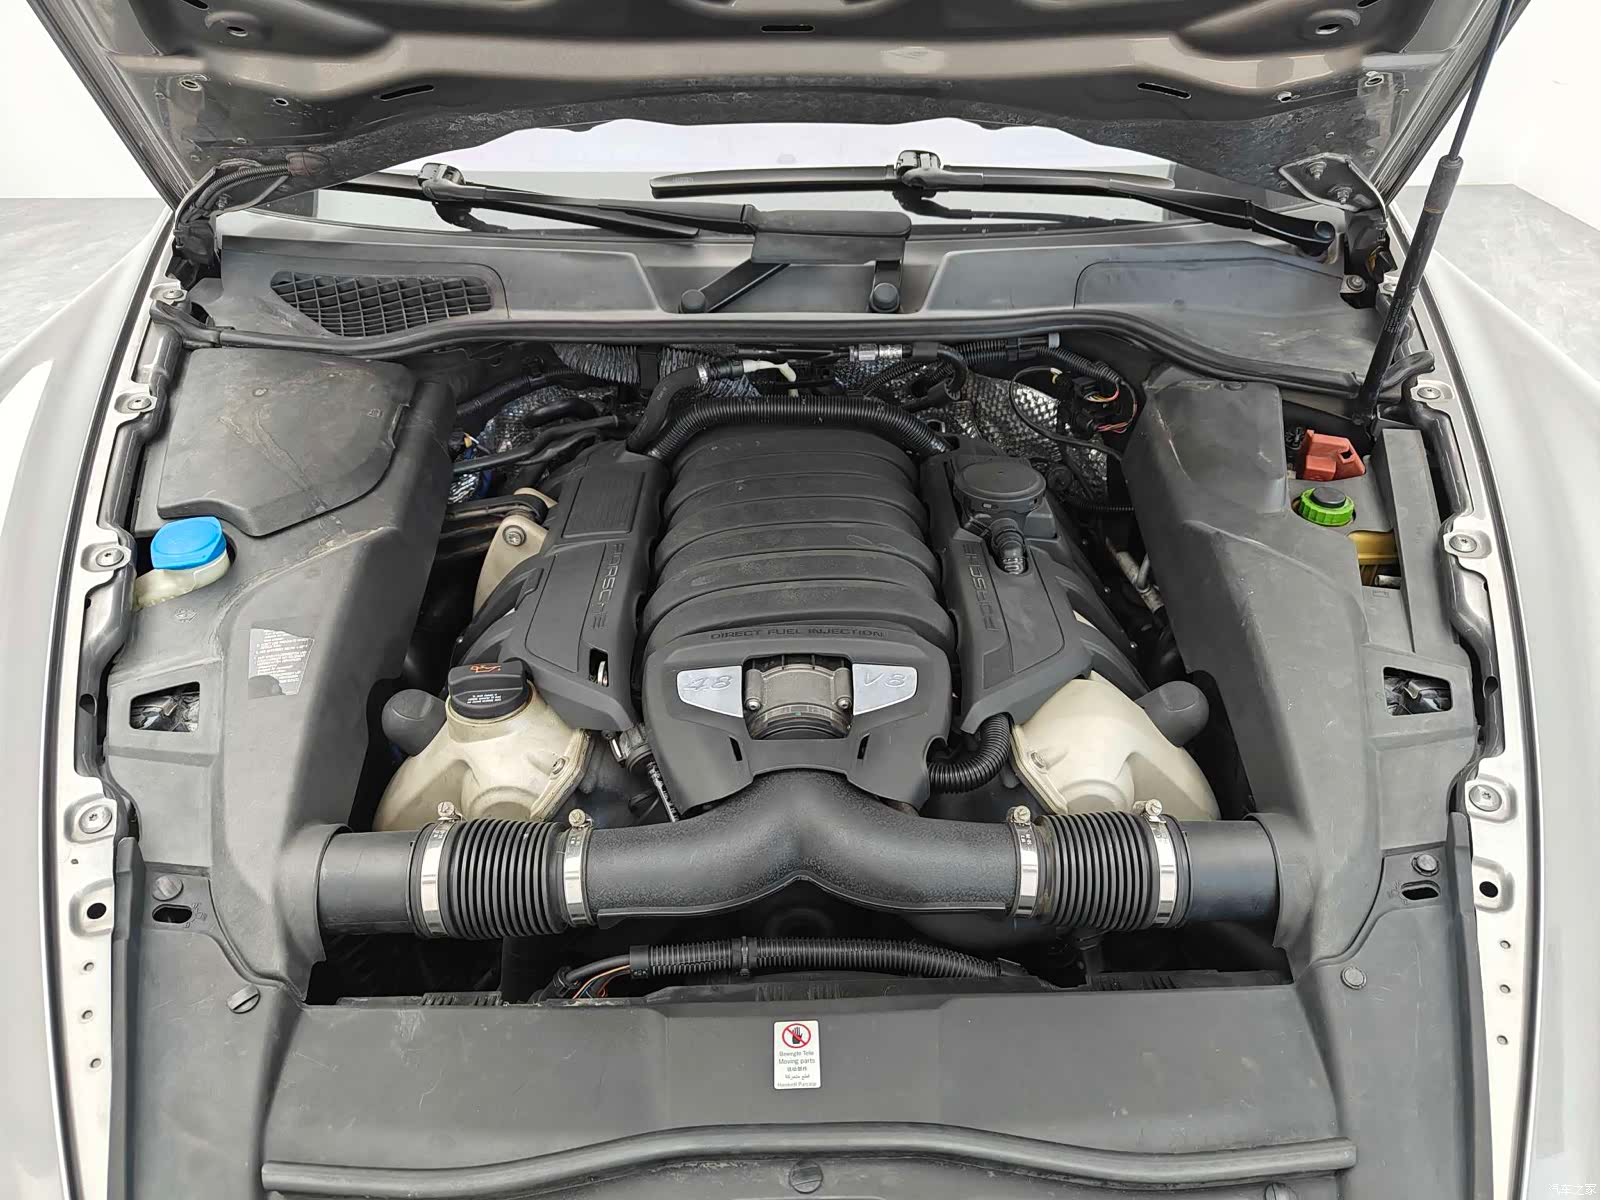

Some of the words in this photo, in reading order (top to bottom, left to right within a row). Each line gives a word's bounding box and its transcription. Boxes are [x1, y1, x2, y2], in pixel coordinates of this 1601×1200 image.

[592, 543, 624, 629] PORSCHE
[963, 543, 1000, 632] PORSCHE
[710, 629, 761, 640] DIRECT
[767, 628, 801, 636] FUEL
[807, 627, 884, 638] INJECTION
[864, 671, 907, 688] V8
